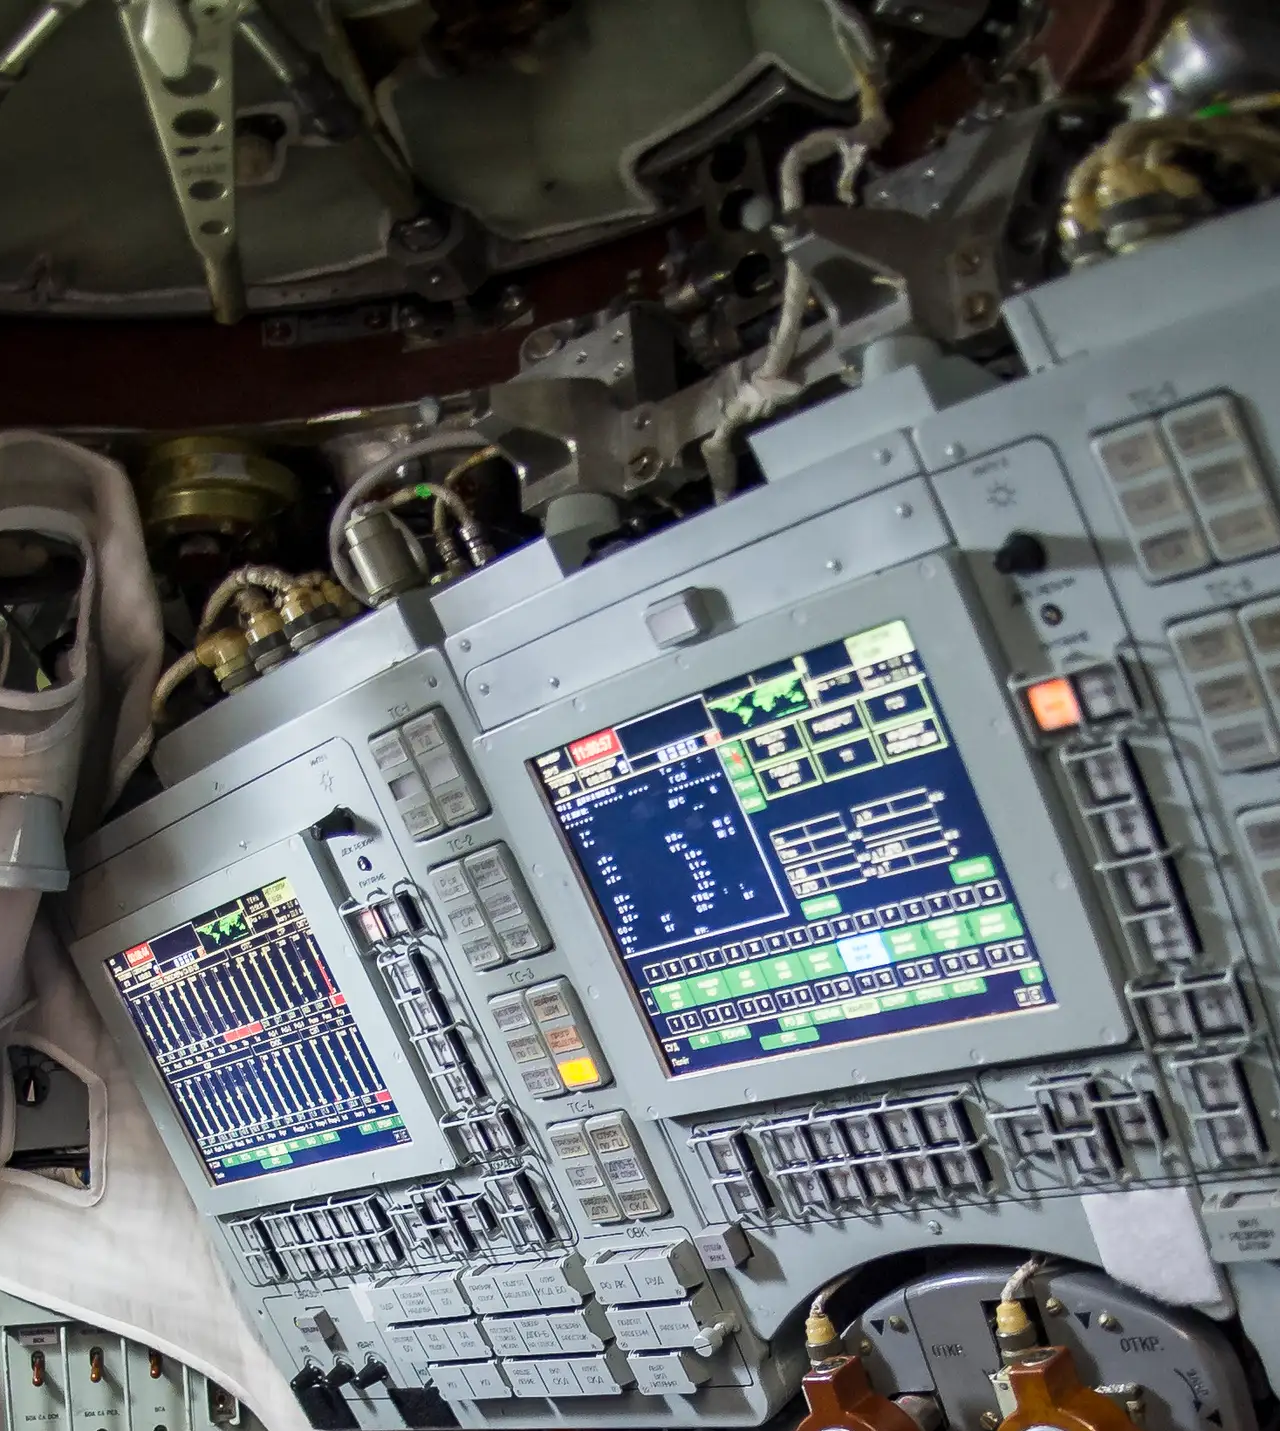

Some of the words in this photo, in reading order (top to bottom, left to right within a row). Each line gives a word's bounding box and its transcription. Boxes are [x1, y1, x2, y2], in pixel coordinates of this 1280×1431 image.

[507, 967, 535, 984] ТС-3
[567, 1100, 594, 1113] ТС-4
[626, 1227, 649, 1238] ОВК
[1120, 1336, 1164, 1353] ОТКР.
